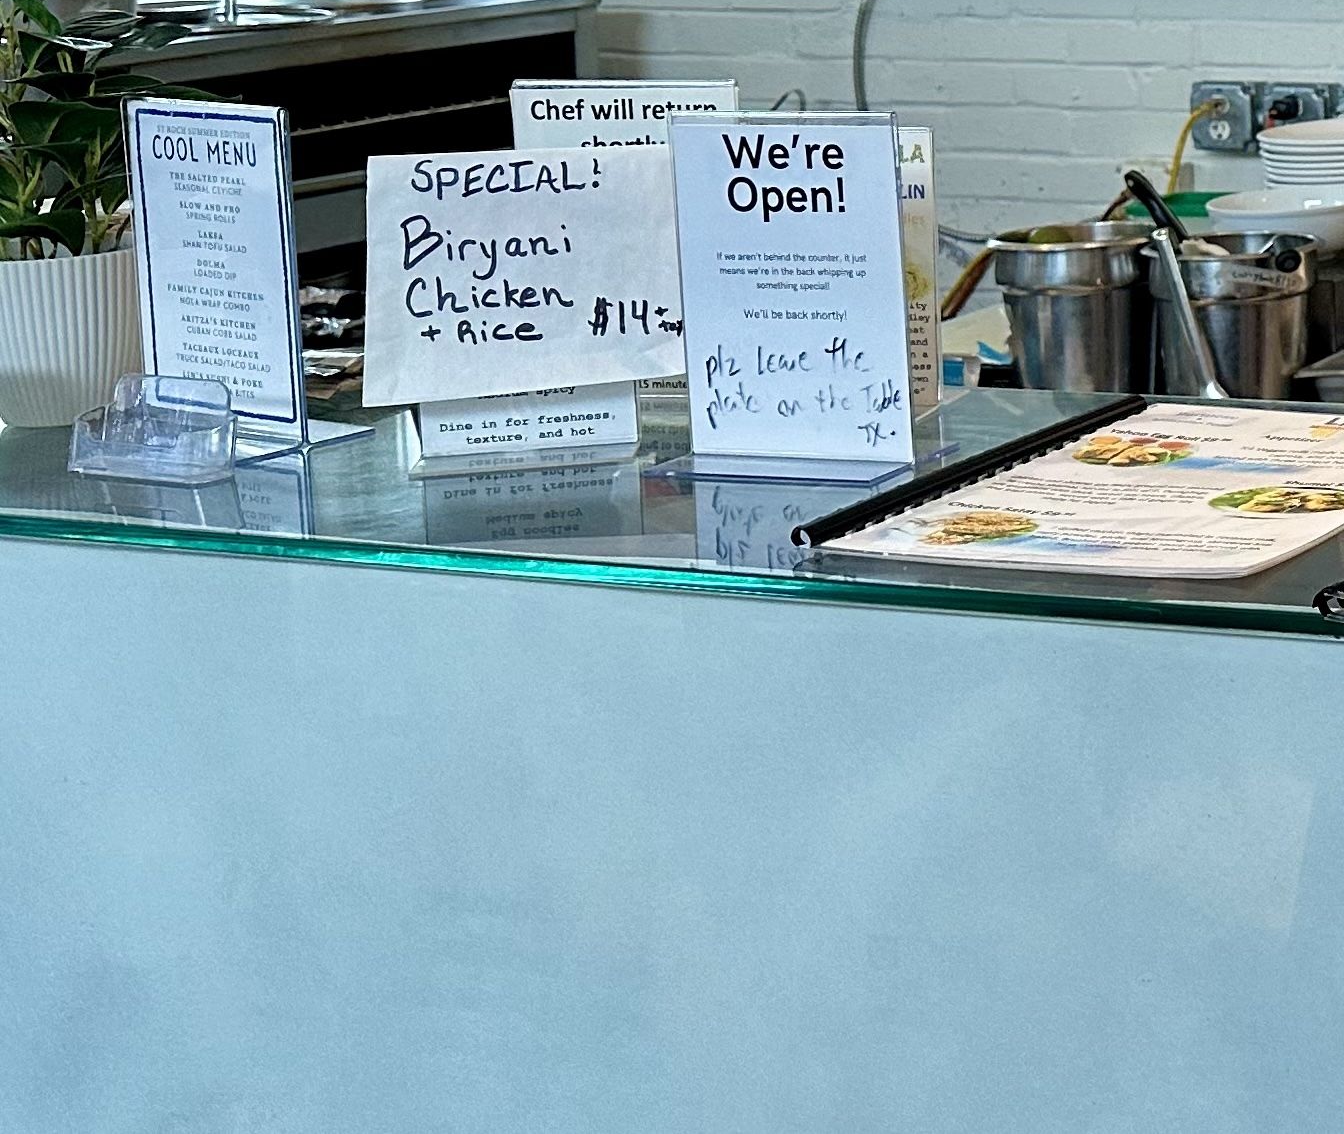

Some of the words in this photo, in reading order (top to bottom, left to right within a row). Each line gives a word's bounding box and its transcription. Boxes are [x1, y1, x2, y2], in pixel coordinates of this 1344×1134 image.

[530, 98, 584, 121] Chef
[591, 98, 634, 120] will
[152, 135, 198, 162] COOL
[206, 140, 256, 167] MENU
[722, 133, 844, 170] We're
[411, 158, 601, 200] SPECIAL!
[180, 201, 201, 209] SLOW
[205, 203, 220, 211] AND
[727, 176, 846, 223] Open!
[401, 215, 572, 282] Biryani
[764, 253, 790, 262] behind
[793, 253, 806, 262] the
[852, 255, 867, 264] just
[771, 267, 779, 275] in
[781, 268, 794, 276] the
[796, 268, 815, 276] back
[818, 268, 854, 278] whipping
[168, 284, 197, 294] FAMILY
[200, 286, 224, 298] CAJUN
[406, 276, 574, 318] Chicken
[756, 282, 798, 291] something
[220, 318, 256, 330] KITCHEN
[587, 297, 651, 337] $14
[771, 310, 783, 319] be
[786, 311, 808, 319] back
[811, 310, 847, 322] shortly!
[421, 325, 441, 342] +
[457, 319, 544, 345] Rice
[706, 344, 741, 388] plz
[815, 384, 850, 413] the
[440, 423, 473, 433] Dine
[481, 419, 497, 429] in
[505, 417, 530, 427] for
[539, 428, 564, 439] and
[571, 426, 595, 437] hot
[948, 501, 1001, 510] Chicken
[1004, 506, 1040, 515] Satay
